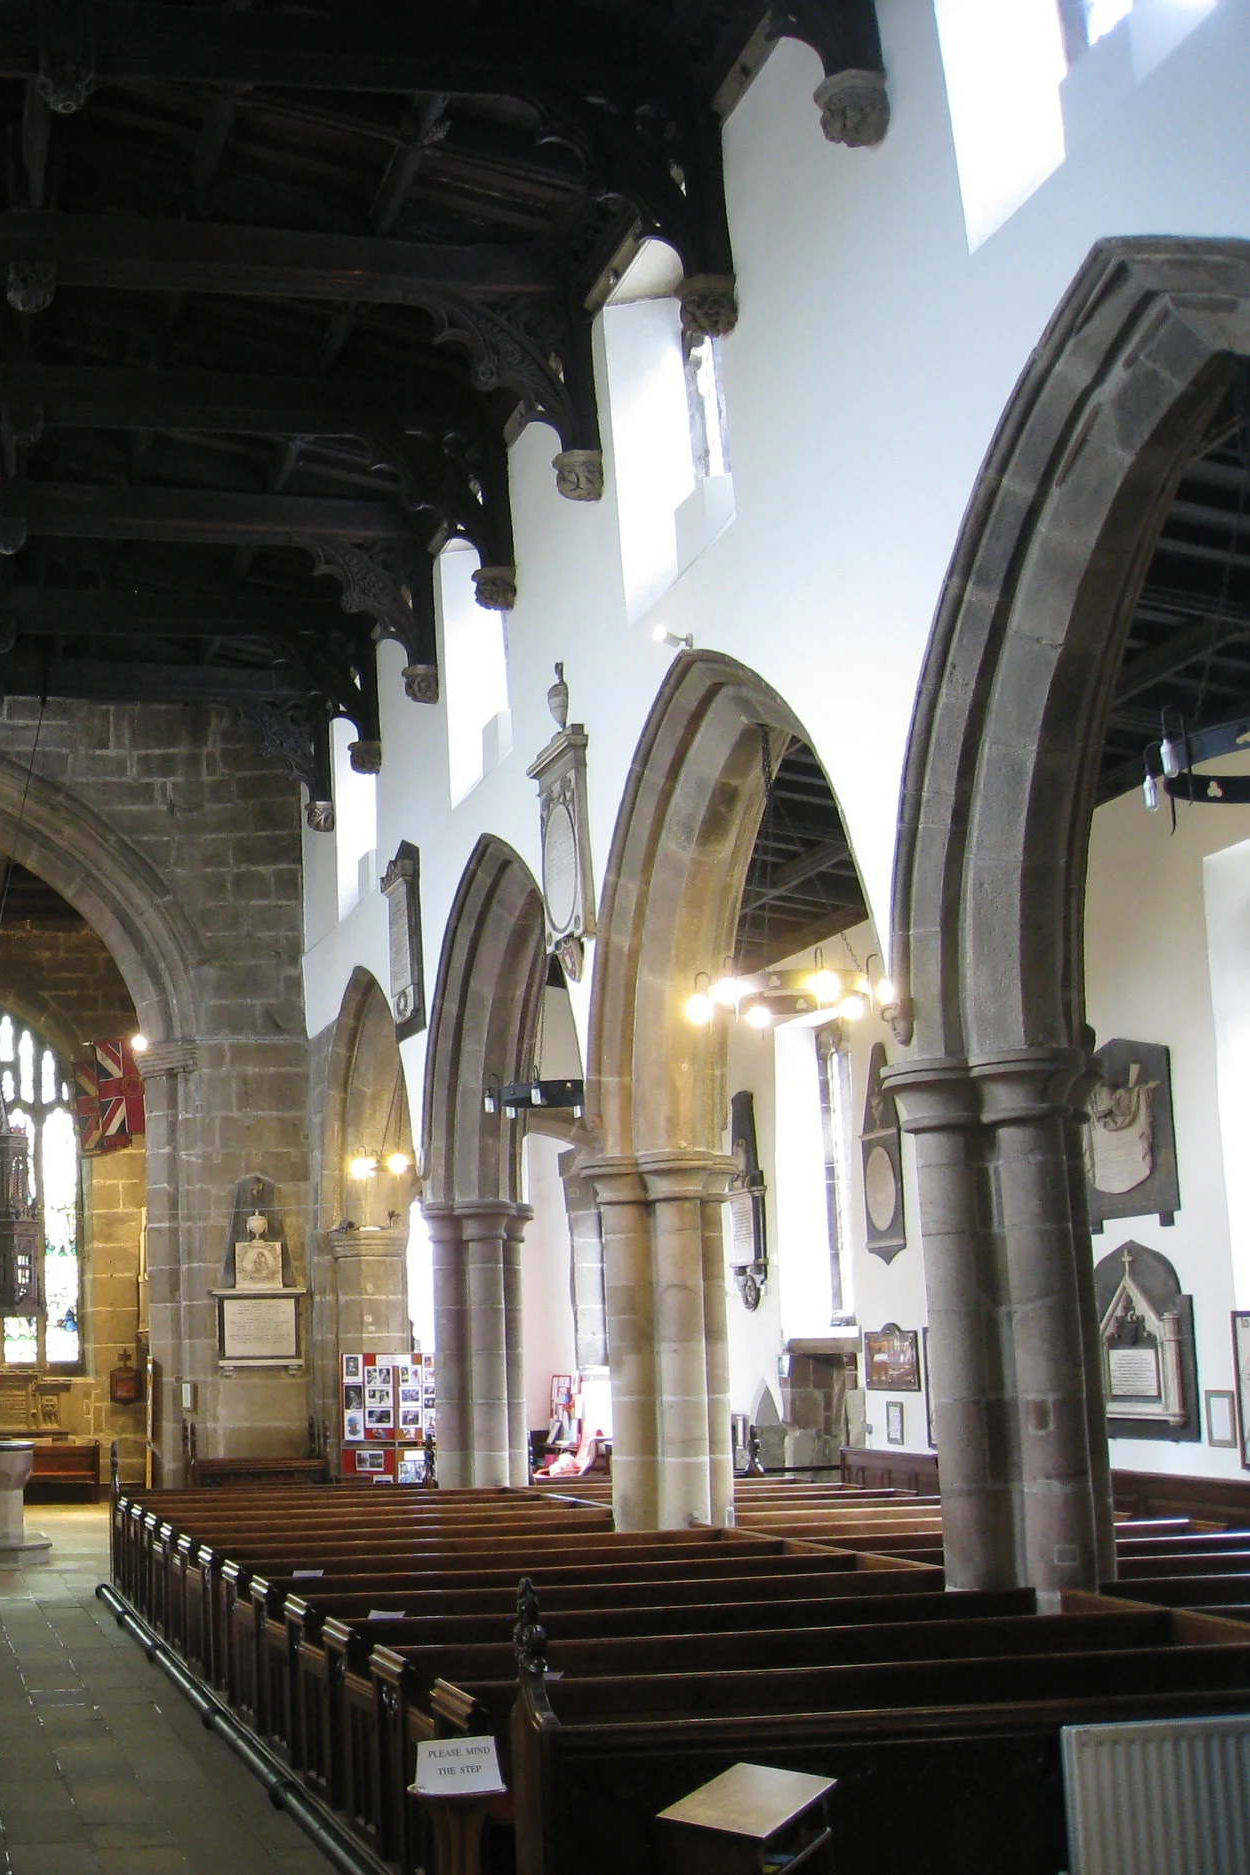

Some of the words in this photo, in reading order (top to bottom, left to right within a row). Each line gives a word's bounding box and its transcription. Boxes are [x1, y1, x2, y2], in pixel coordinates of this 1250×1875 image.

[428, 1747, 461, 1758] PLEASE
[465, 1746, 490, 1755] MIND
[438, 1766, 455, 1775] THE
[459, 1765, 482, 1774] STEP
